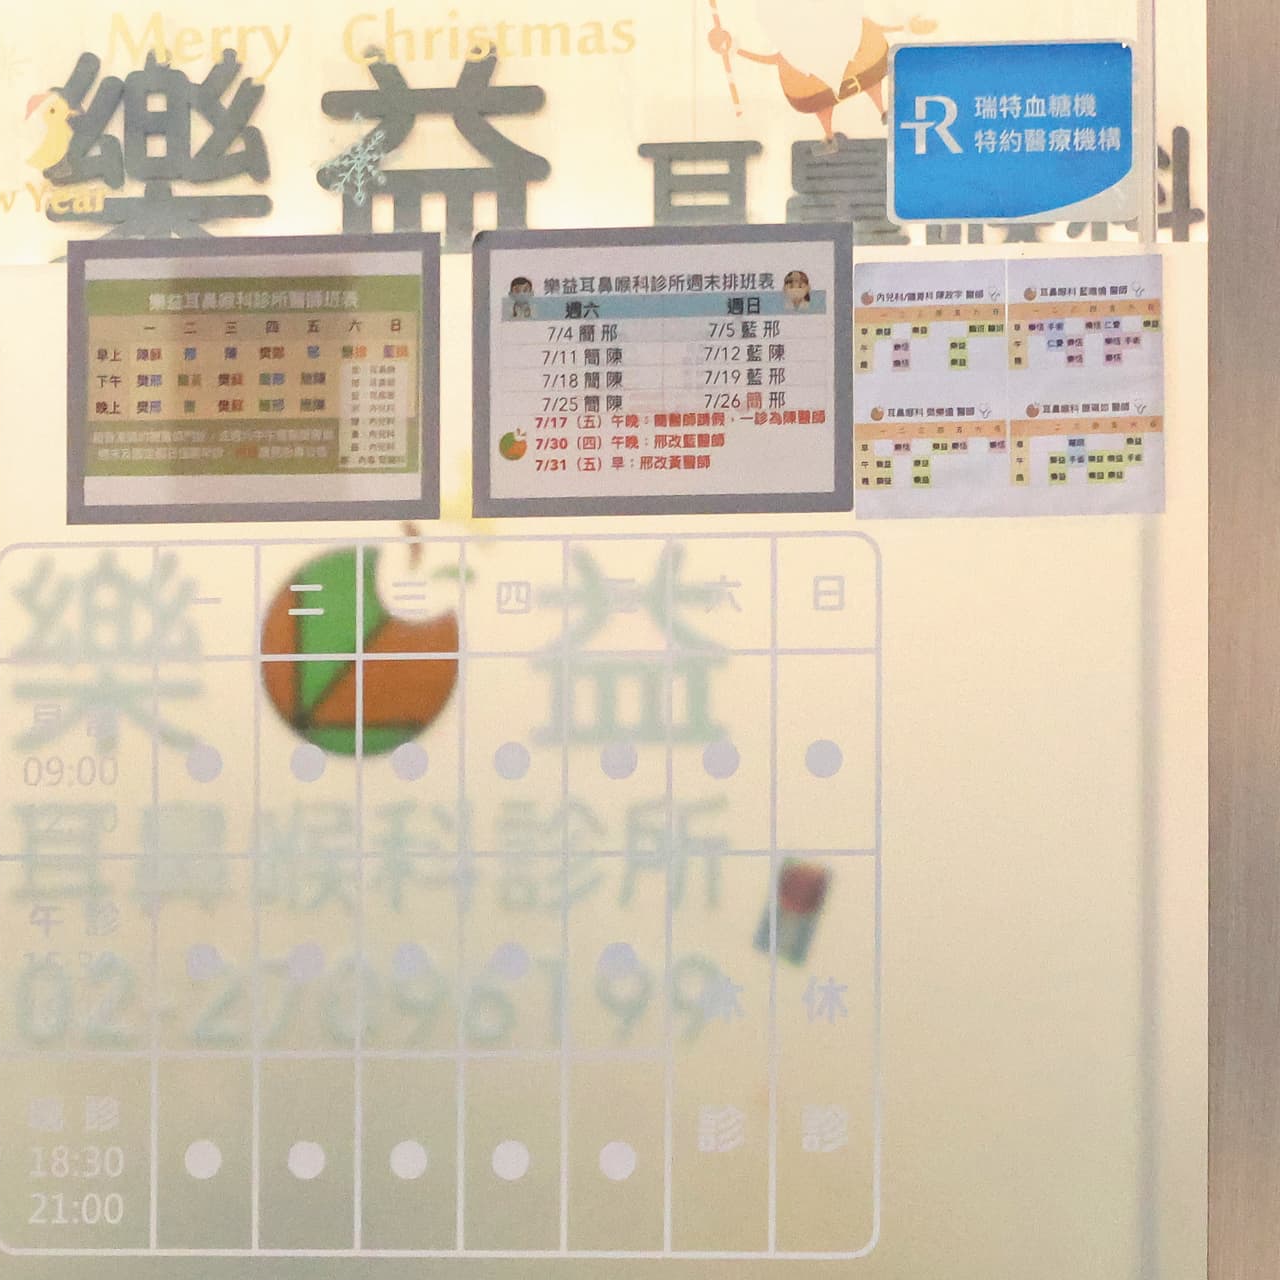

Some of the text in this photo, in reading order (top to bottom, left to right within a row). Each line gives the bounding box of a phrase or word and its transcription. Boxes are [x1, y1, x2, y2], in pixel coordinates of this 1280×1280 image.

[108, 8, 636, 72] Merry Christmas
[974, 94, 1098, 120] 瑞特血糖機
[974, 126, 1122, 153] 特約醫療機構
[544, 272, 775, 295] 樂益耳鼻喉科診所週末排班表
[565, 297, 761, 319] 週六 週日
[547, 326, 573, 342] 7/4
[708, 322, 735, 338] 7/5
[542, 350, 577, 367] 7/11
[704, 346, 740, 362] 7/12
[542, 373, 578, 389] 7/18
[704, 370, 741, 385] 7/19
[542, 397, 578, 412] 7/25
[704, 393, 741, 409] 7/26
[535, 416, 568, 429] 7/17
[535, 437, 568, 450] 7/30
[535, 459, 568, 472] 7/31
[813, 575, 846, 613] 日
[23, 755, 118, 787] 09:00
[28, 1145, 125, 1178] 18:30
[27, 1192, 125, 1225] 21:00
